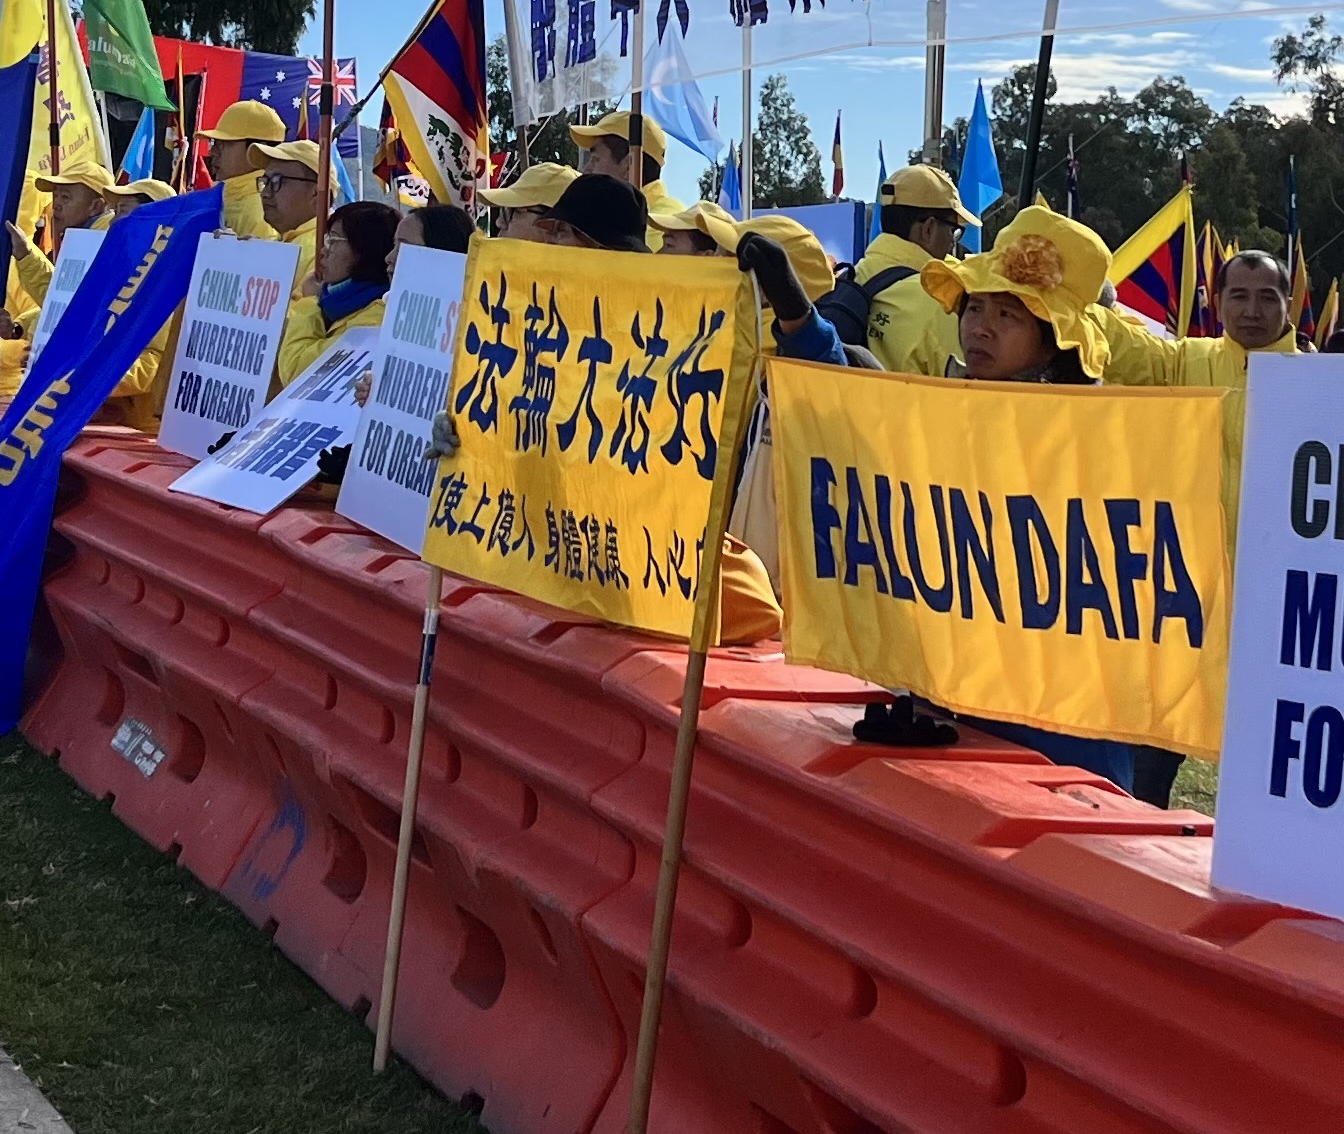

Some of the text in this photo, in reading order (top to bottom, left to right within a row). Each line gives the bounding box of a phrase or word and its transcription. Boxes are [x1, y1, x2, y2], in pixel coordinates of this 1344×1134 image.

[197, 268, 243, 314] CHINA:
[242, 276, 281, 321] STOP
[186, 319, 268, 376] MURDERING
[456, 270, 726, 481] 法輪大法好
[174, 371, 255, 428] FOR ORGANS
[375, 354, 449, 421] MURDERI
[359, 419, 440, 498] FOR ORGAN
[810, 457, 1204, 649] FALUN DAFA
